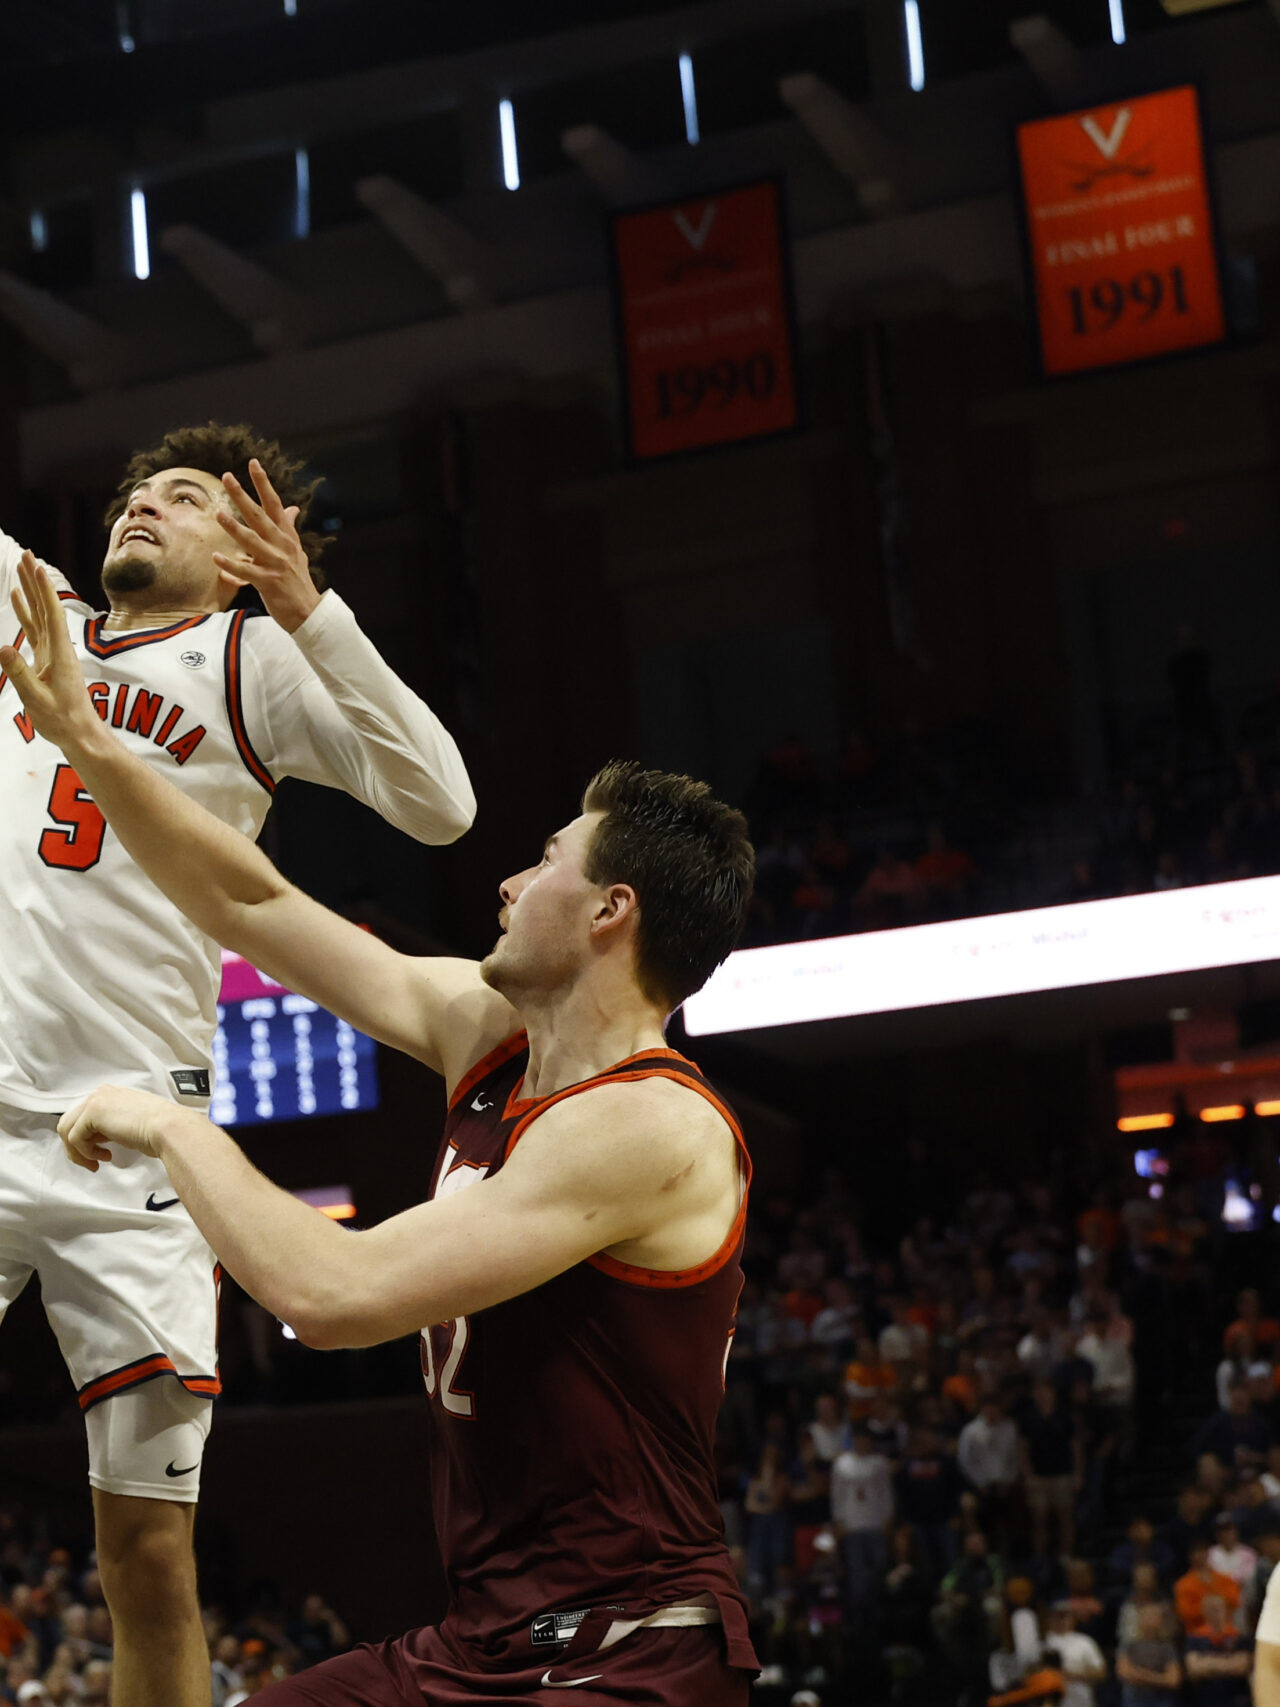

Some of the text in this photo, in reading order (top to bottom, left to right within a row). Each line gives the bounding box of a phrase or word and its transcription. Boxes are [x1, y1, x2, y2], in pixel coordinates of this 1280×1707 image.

[1079, 107, 1132, 159] V
[1046, 214, 1195, 267] FINAL FOUR
[1068, 266, 1189, 336] 1991
[656, 352, 775, 420] 1990
[13, 682, 207, 766] VGINIA
[38, 764, 107, 872] 5
